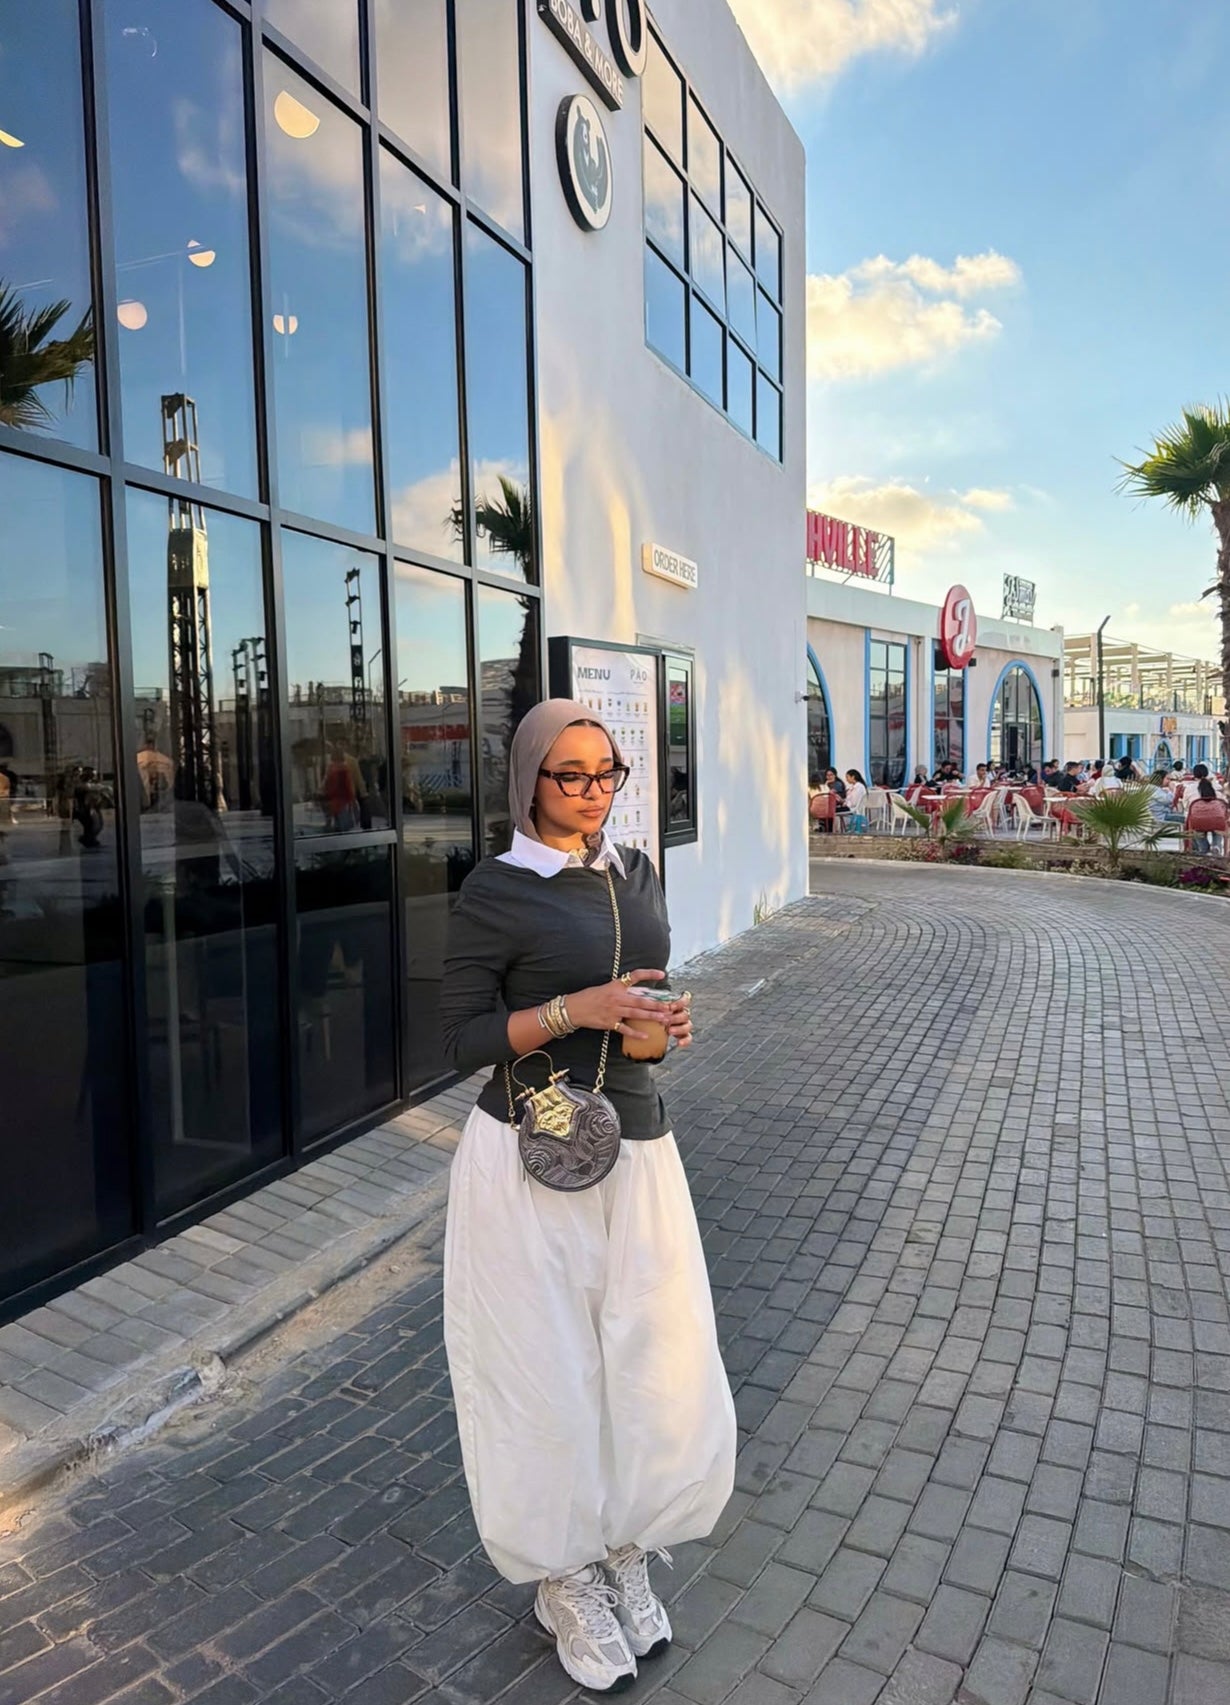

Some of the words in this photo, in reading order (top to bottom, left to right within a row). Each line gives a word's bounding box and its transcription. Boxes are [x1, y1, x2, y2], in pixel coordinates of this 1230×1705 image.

[584, 32, 593, 63] &
[594, 47, 623, 105] MORE
[654, 549, 679, 577] ORDER
[679, 560, 696, 583] HERE
[577, 667, 611, 680] MENU
